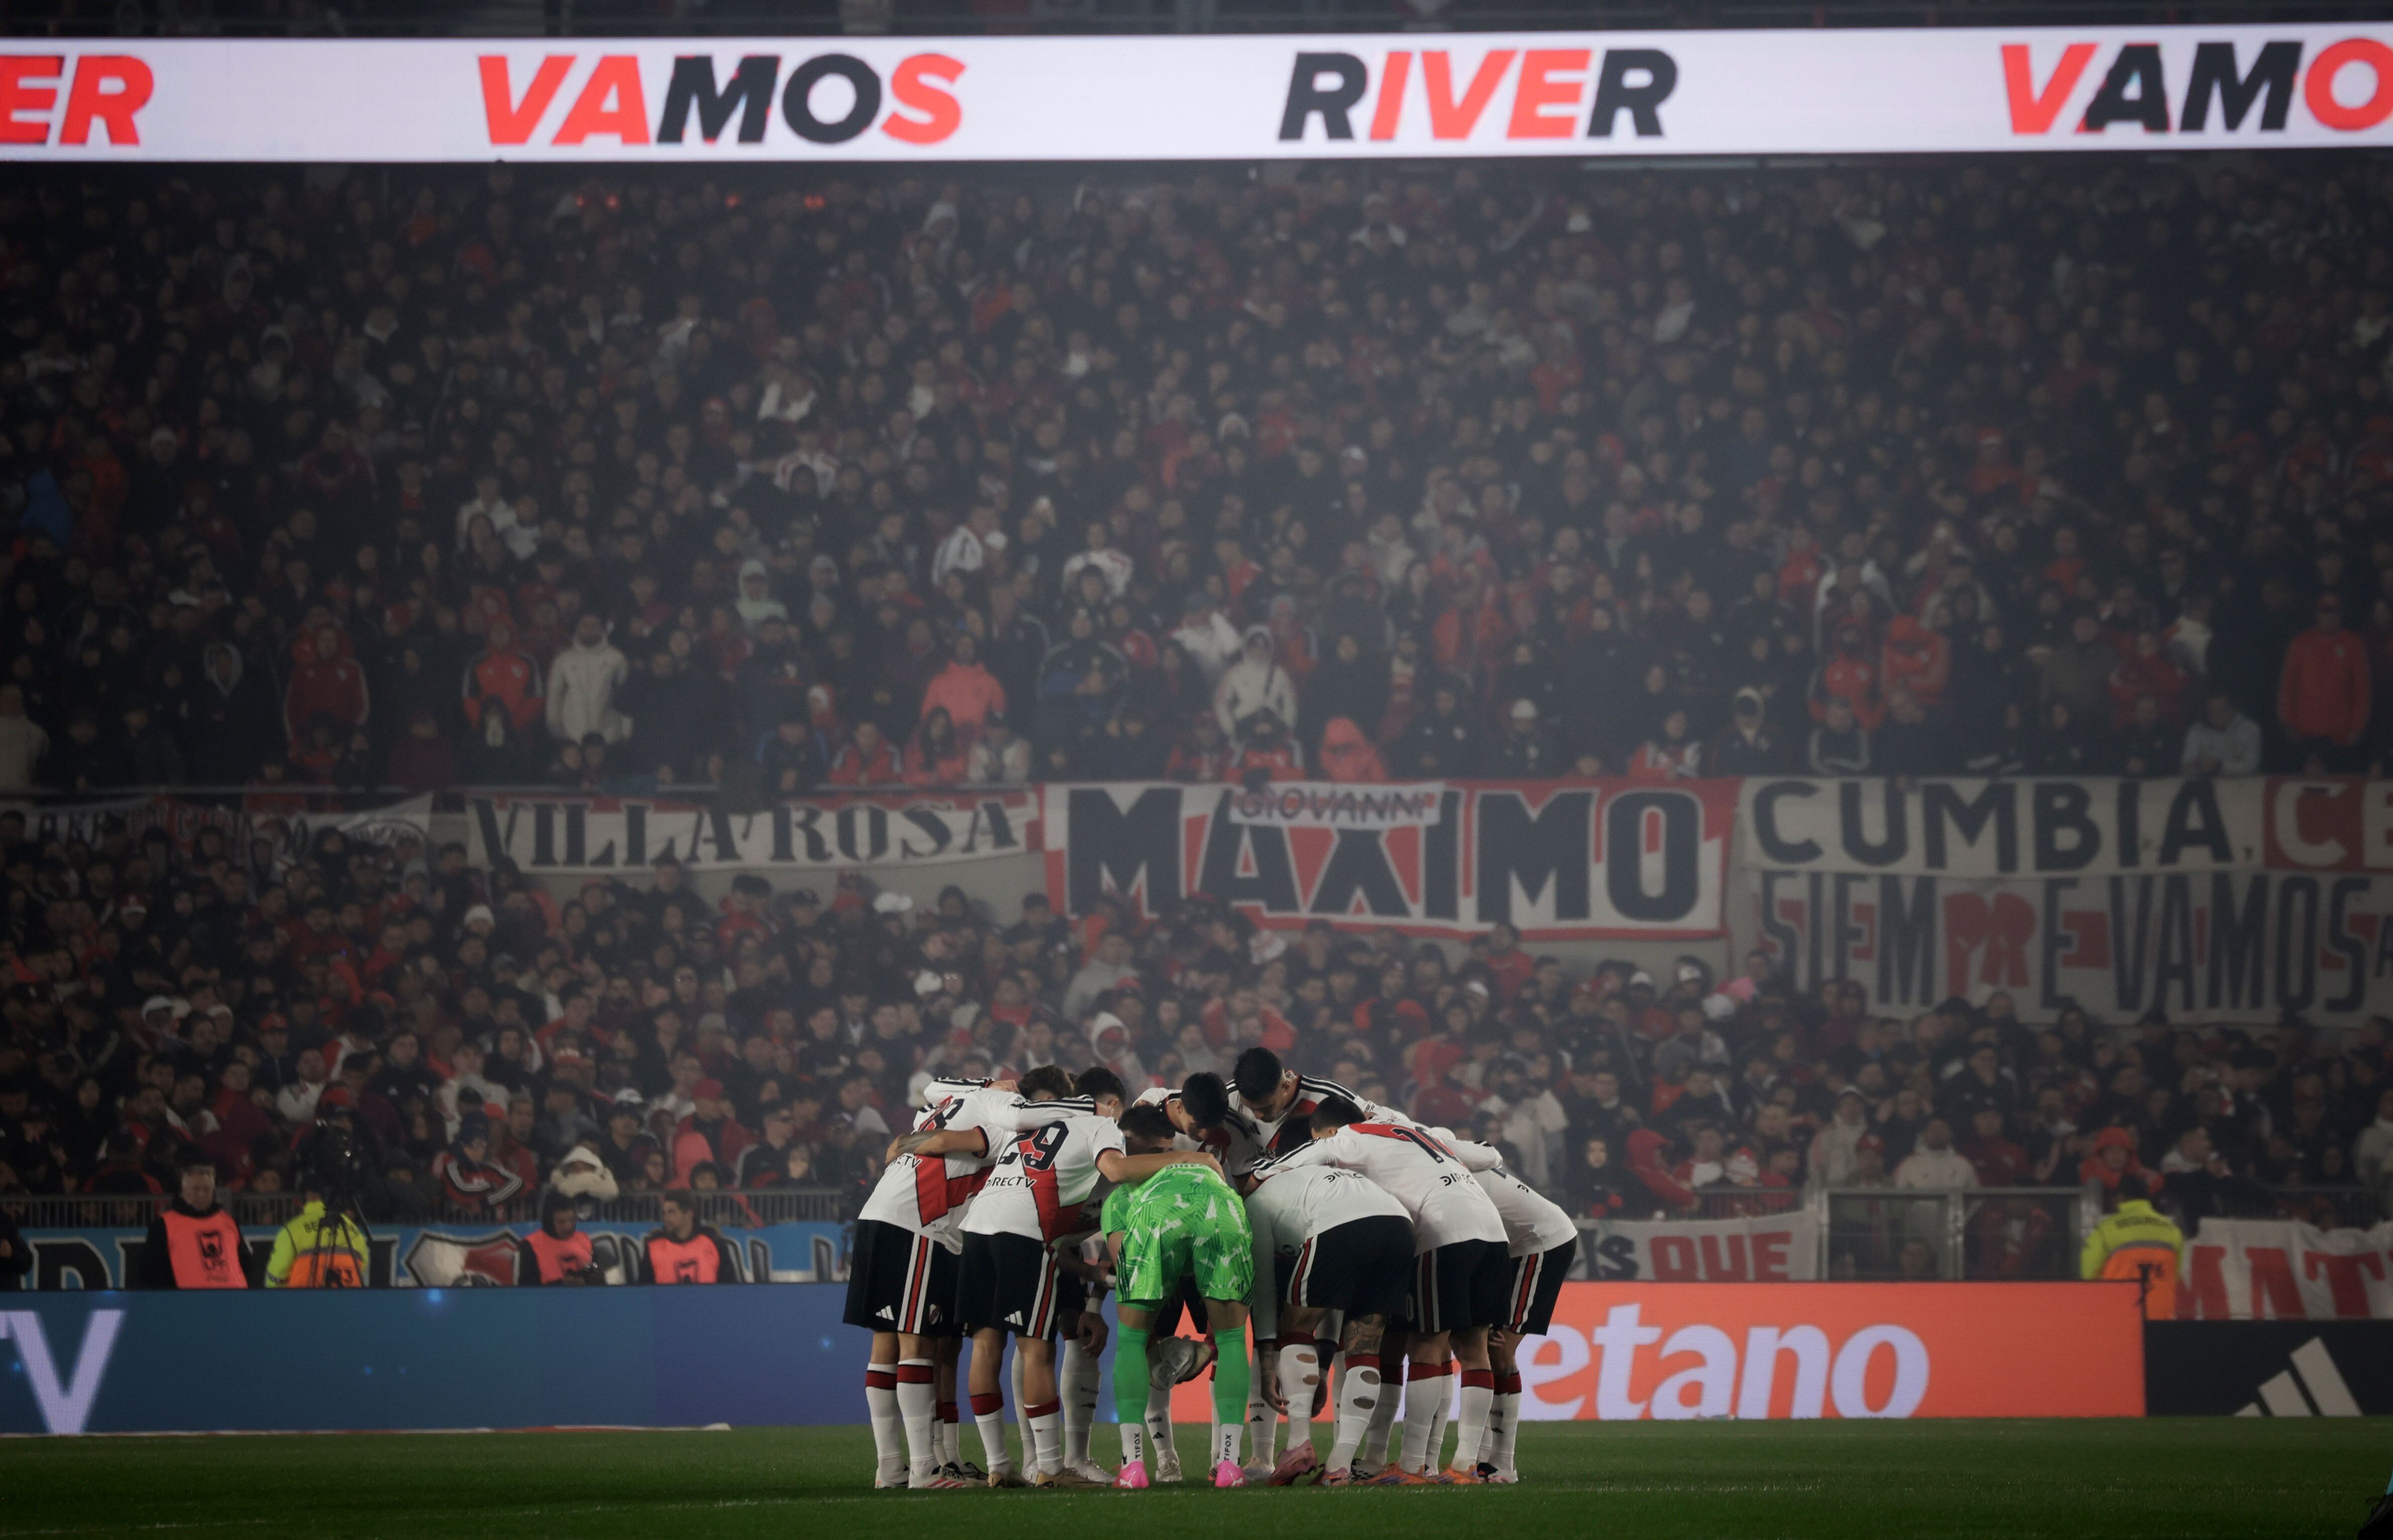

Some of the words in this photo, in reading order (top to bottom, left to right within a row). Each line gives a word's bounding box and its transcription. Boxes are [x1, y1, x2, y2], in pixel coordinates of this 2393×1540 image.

[477, 53, 966, 144] VAMOS
[1278, 48, 1678, 141] RIVER
[2001, 38, 2393, 135] VAMO
[770, 802, 1018, 862] ROSA
[1239, 788, 1426, 823] GIOVANNI
[1066, 787, 1702, 921] MAXIMO
[1760, 871, 2078, 1008] SIEMPRE
[2109, 872, 2371, 1012] VAMOS
[998, 1121, 1069, 1171] 29
[1650, 1231, 1792, 1281] QUE
[2176, 1246, 2393, 1321] MAT
[0, 1309, 125, 1435] V
[1400, 1303, 1930, 1420] etano
[1224, 1433, 1232, 1461] TIFOX
